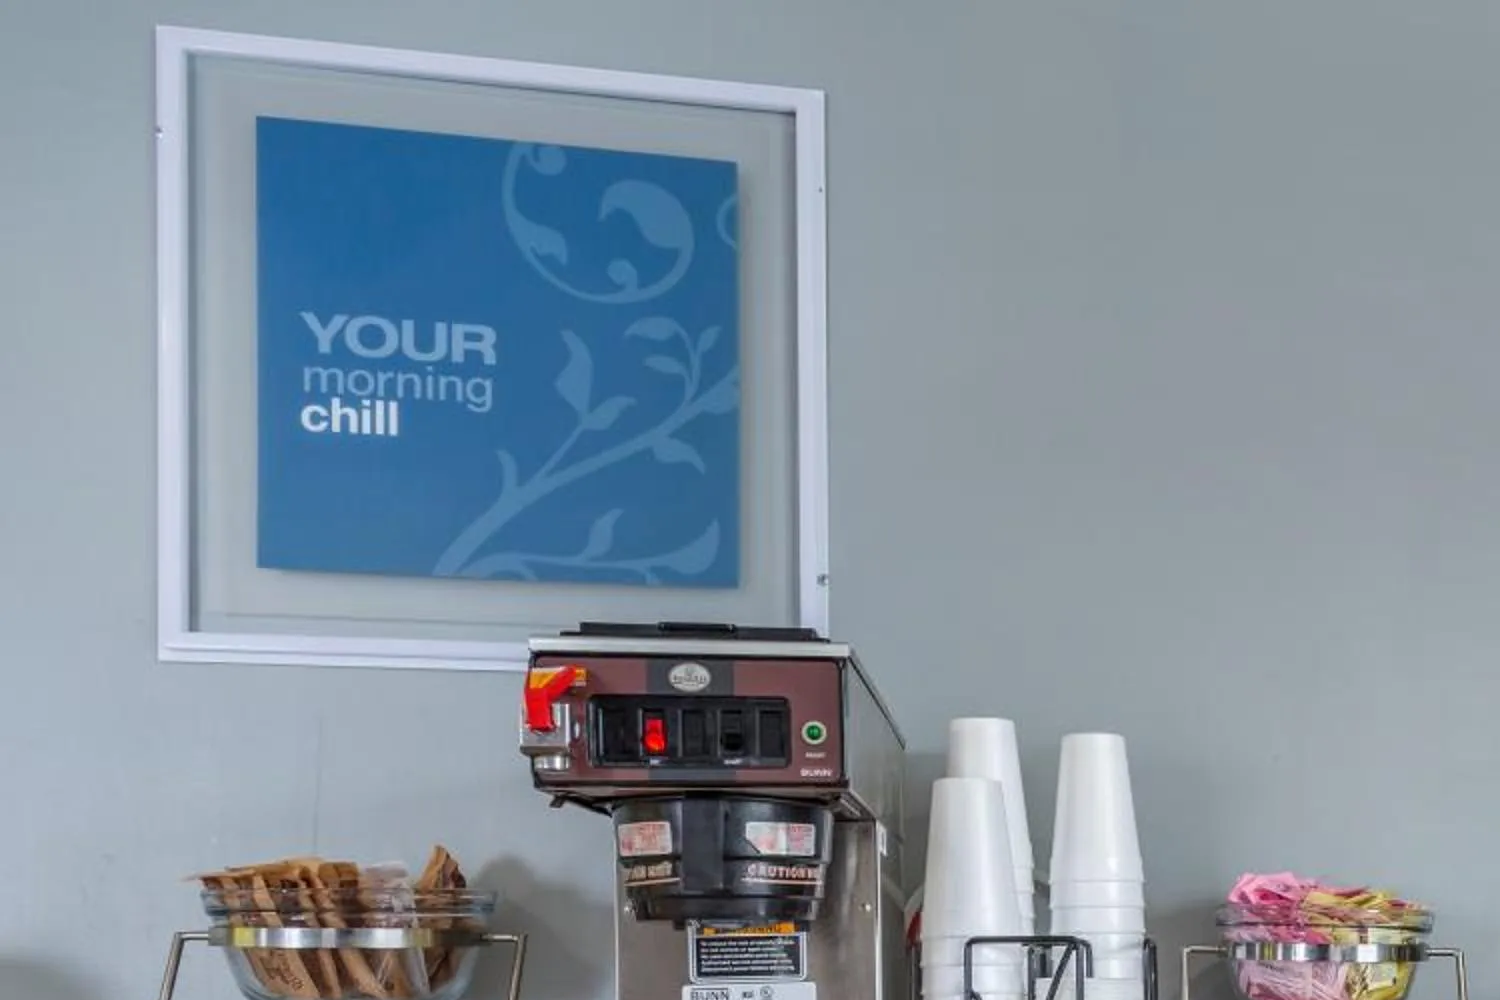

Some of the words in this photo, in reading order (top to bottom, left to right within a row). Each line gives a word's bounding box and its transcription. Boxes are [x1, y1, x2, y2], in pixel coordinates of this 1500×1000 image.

[299, 311, 497, 365] YOUR
[303, 366, 493, 413] morning
[300, 397, 398, 436] chill
[690, 989, 730, 1000] BUNN
